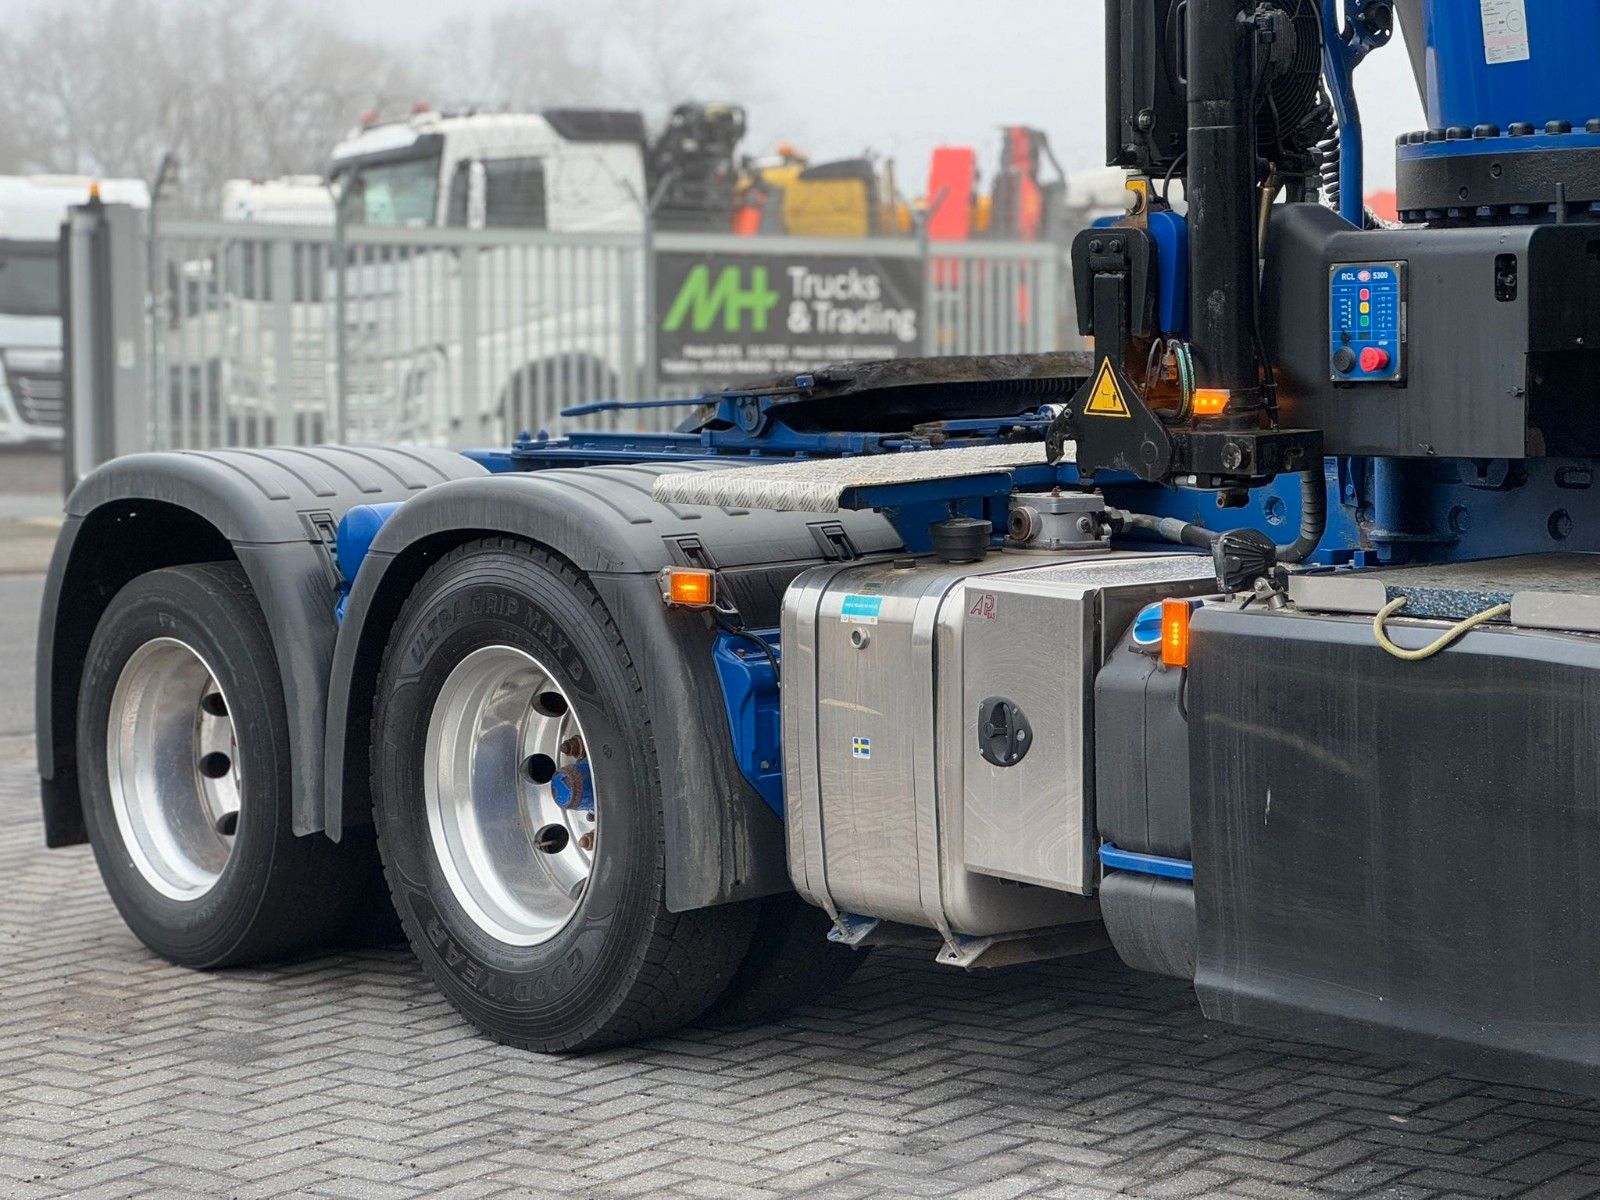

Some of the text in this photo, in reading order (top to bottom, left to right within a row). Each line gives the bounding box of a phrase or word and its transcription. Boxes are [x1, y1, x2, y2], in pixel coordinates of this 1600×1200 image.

[662, 264, 780, 332] MH
[786, 266, 881, 300] Trucks
[1372, 271, 1388, 280] 5300
[786, 302, 917, 342] & Trading
[411, 599, 464, 666] ULTRA
[470, 592, 520, 617] GRIP
[523, 605, 570, 658] MAX
[425, 918, 584, 1001] GOODYEAR
